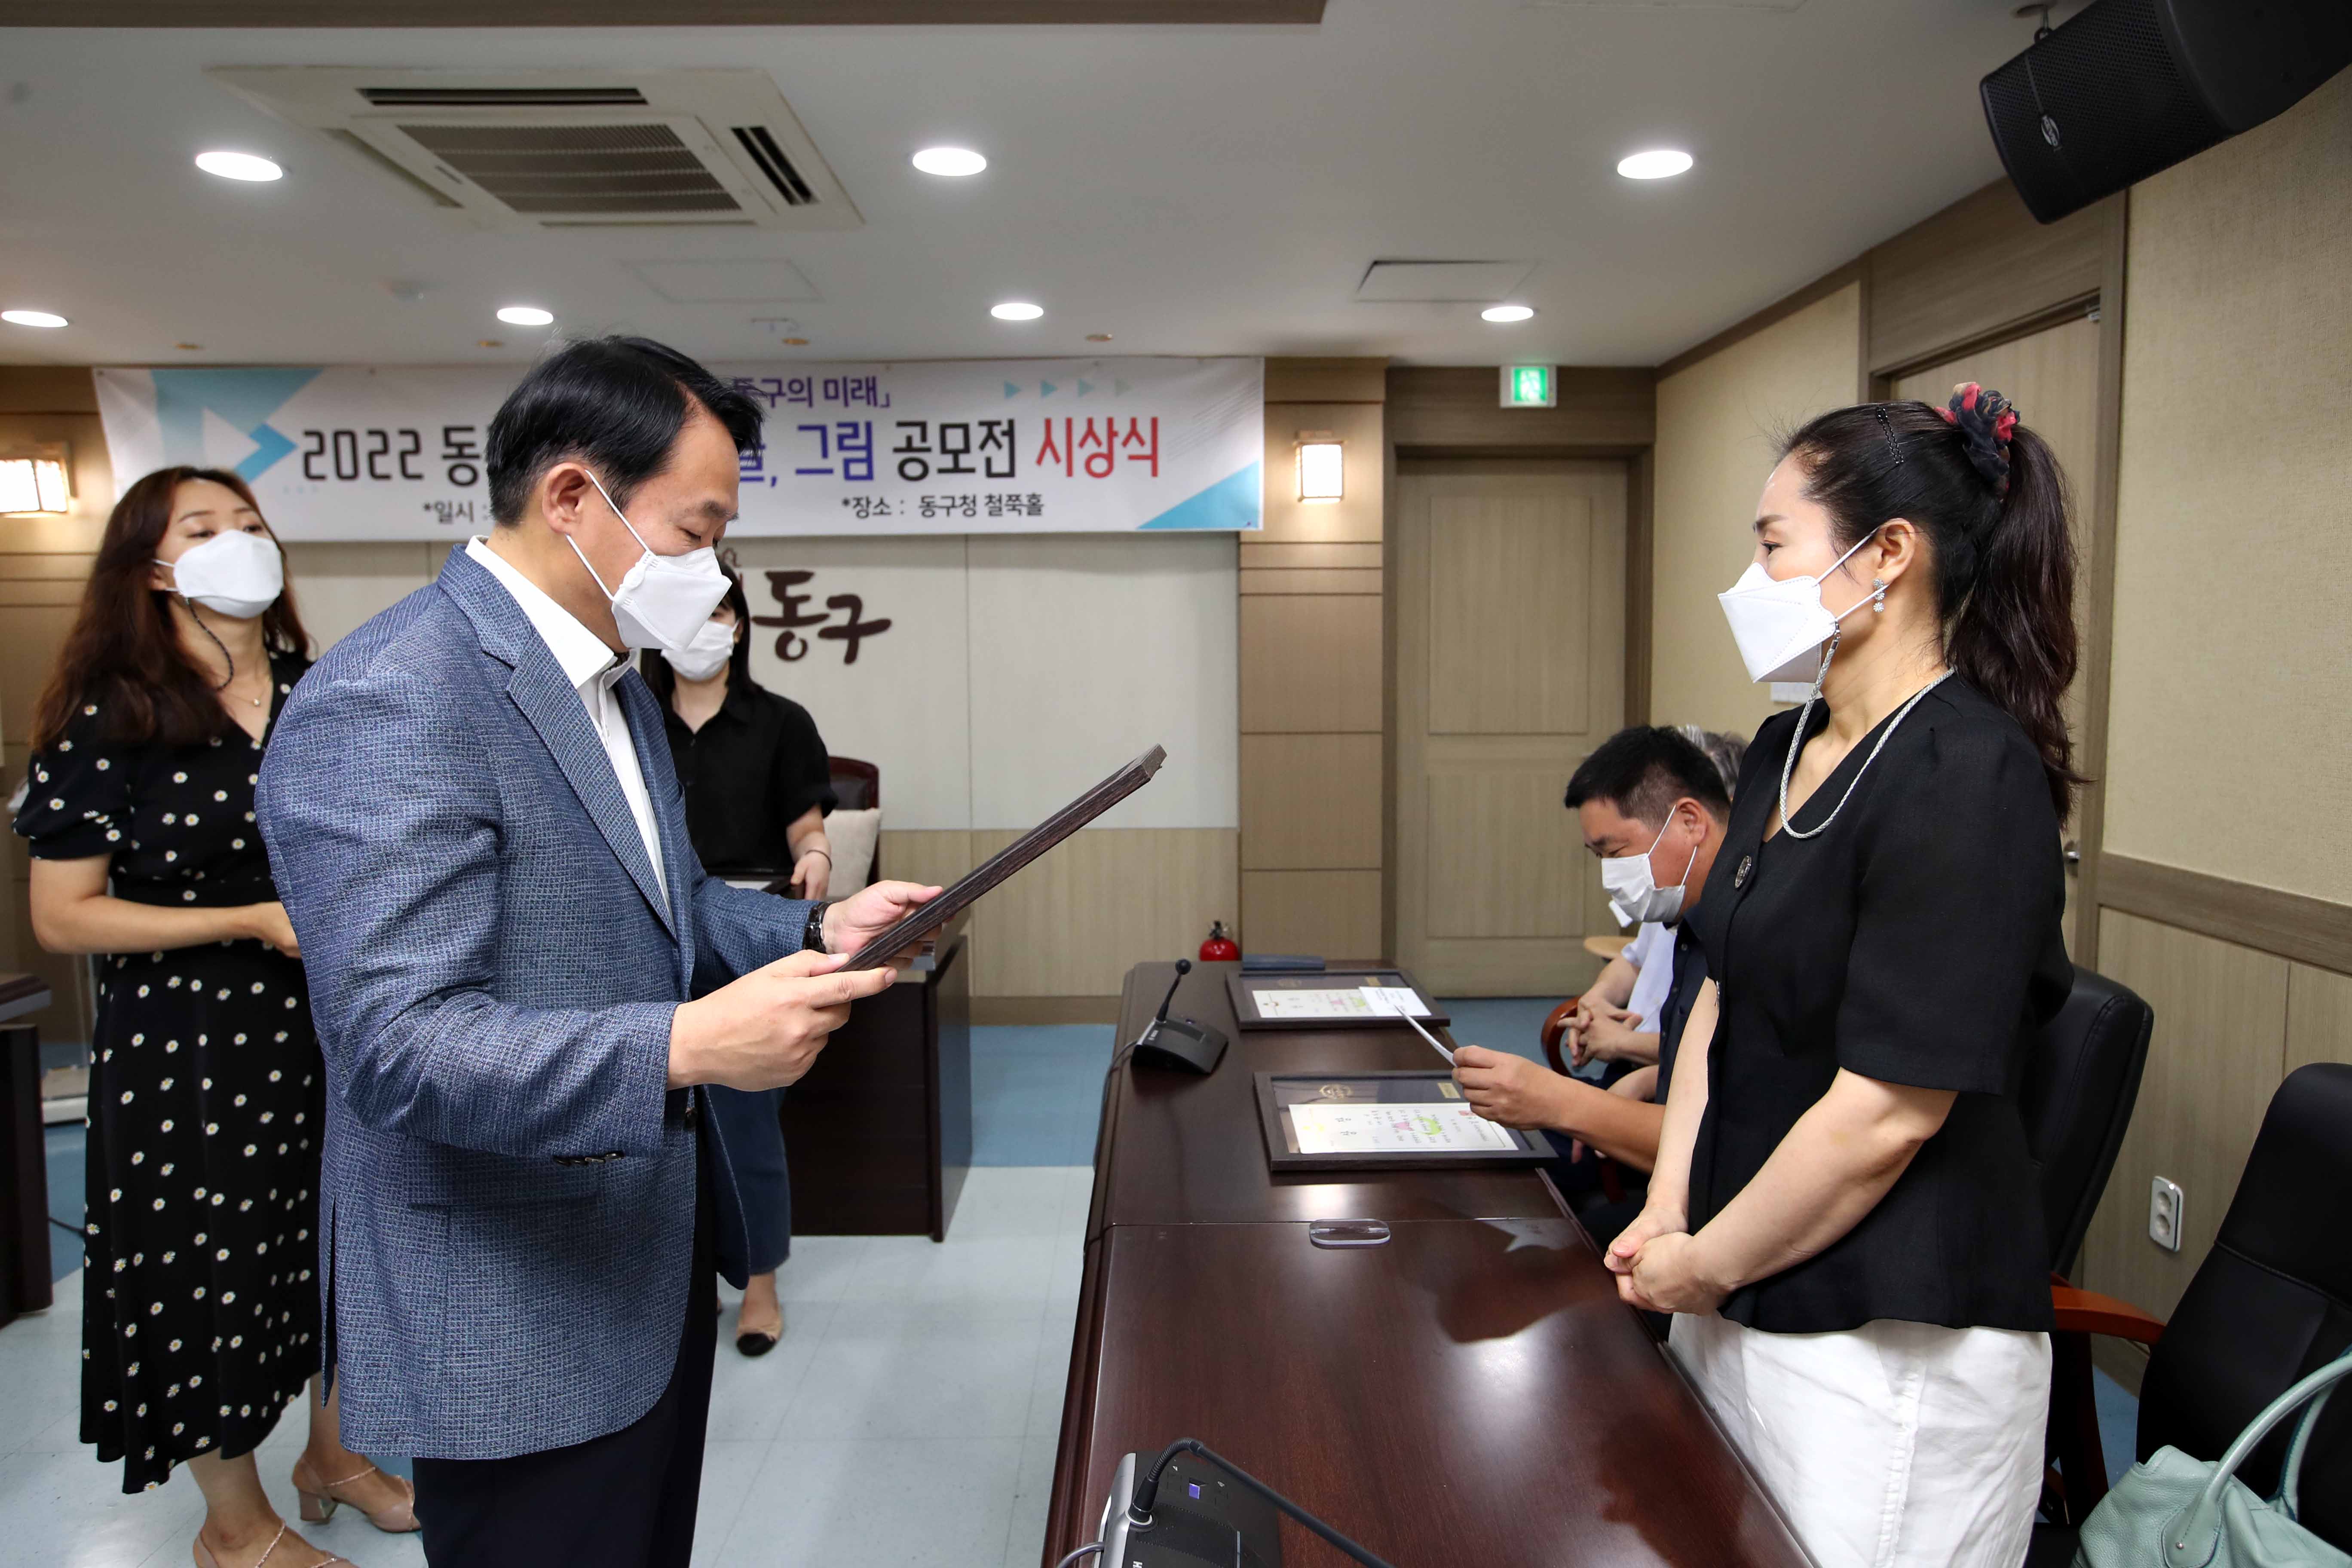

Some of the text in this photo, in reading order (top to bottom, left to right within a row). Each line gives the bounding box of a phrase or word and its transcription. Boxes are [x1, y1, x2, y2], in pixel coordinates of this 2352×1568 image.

[302, 429, 424, 482] 2022
[441, 426, 489, 487] 동
[795, 420, 874, 481] 그림
[892, 418, 1016, 482] 공모전
[1035, 416, 1158, 479] 시상식
[918, 494, 977, 518] 동구청
[984, 493, 1044, 517] 철쭉홀
[751, 570, 892, 665] 동구
